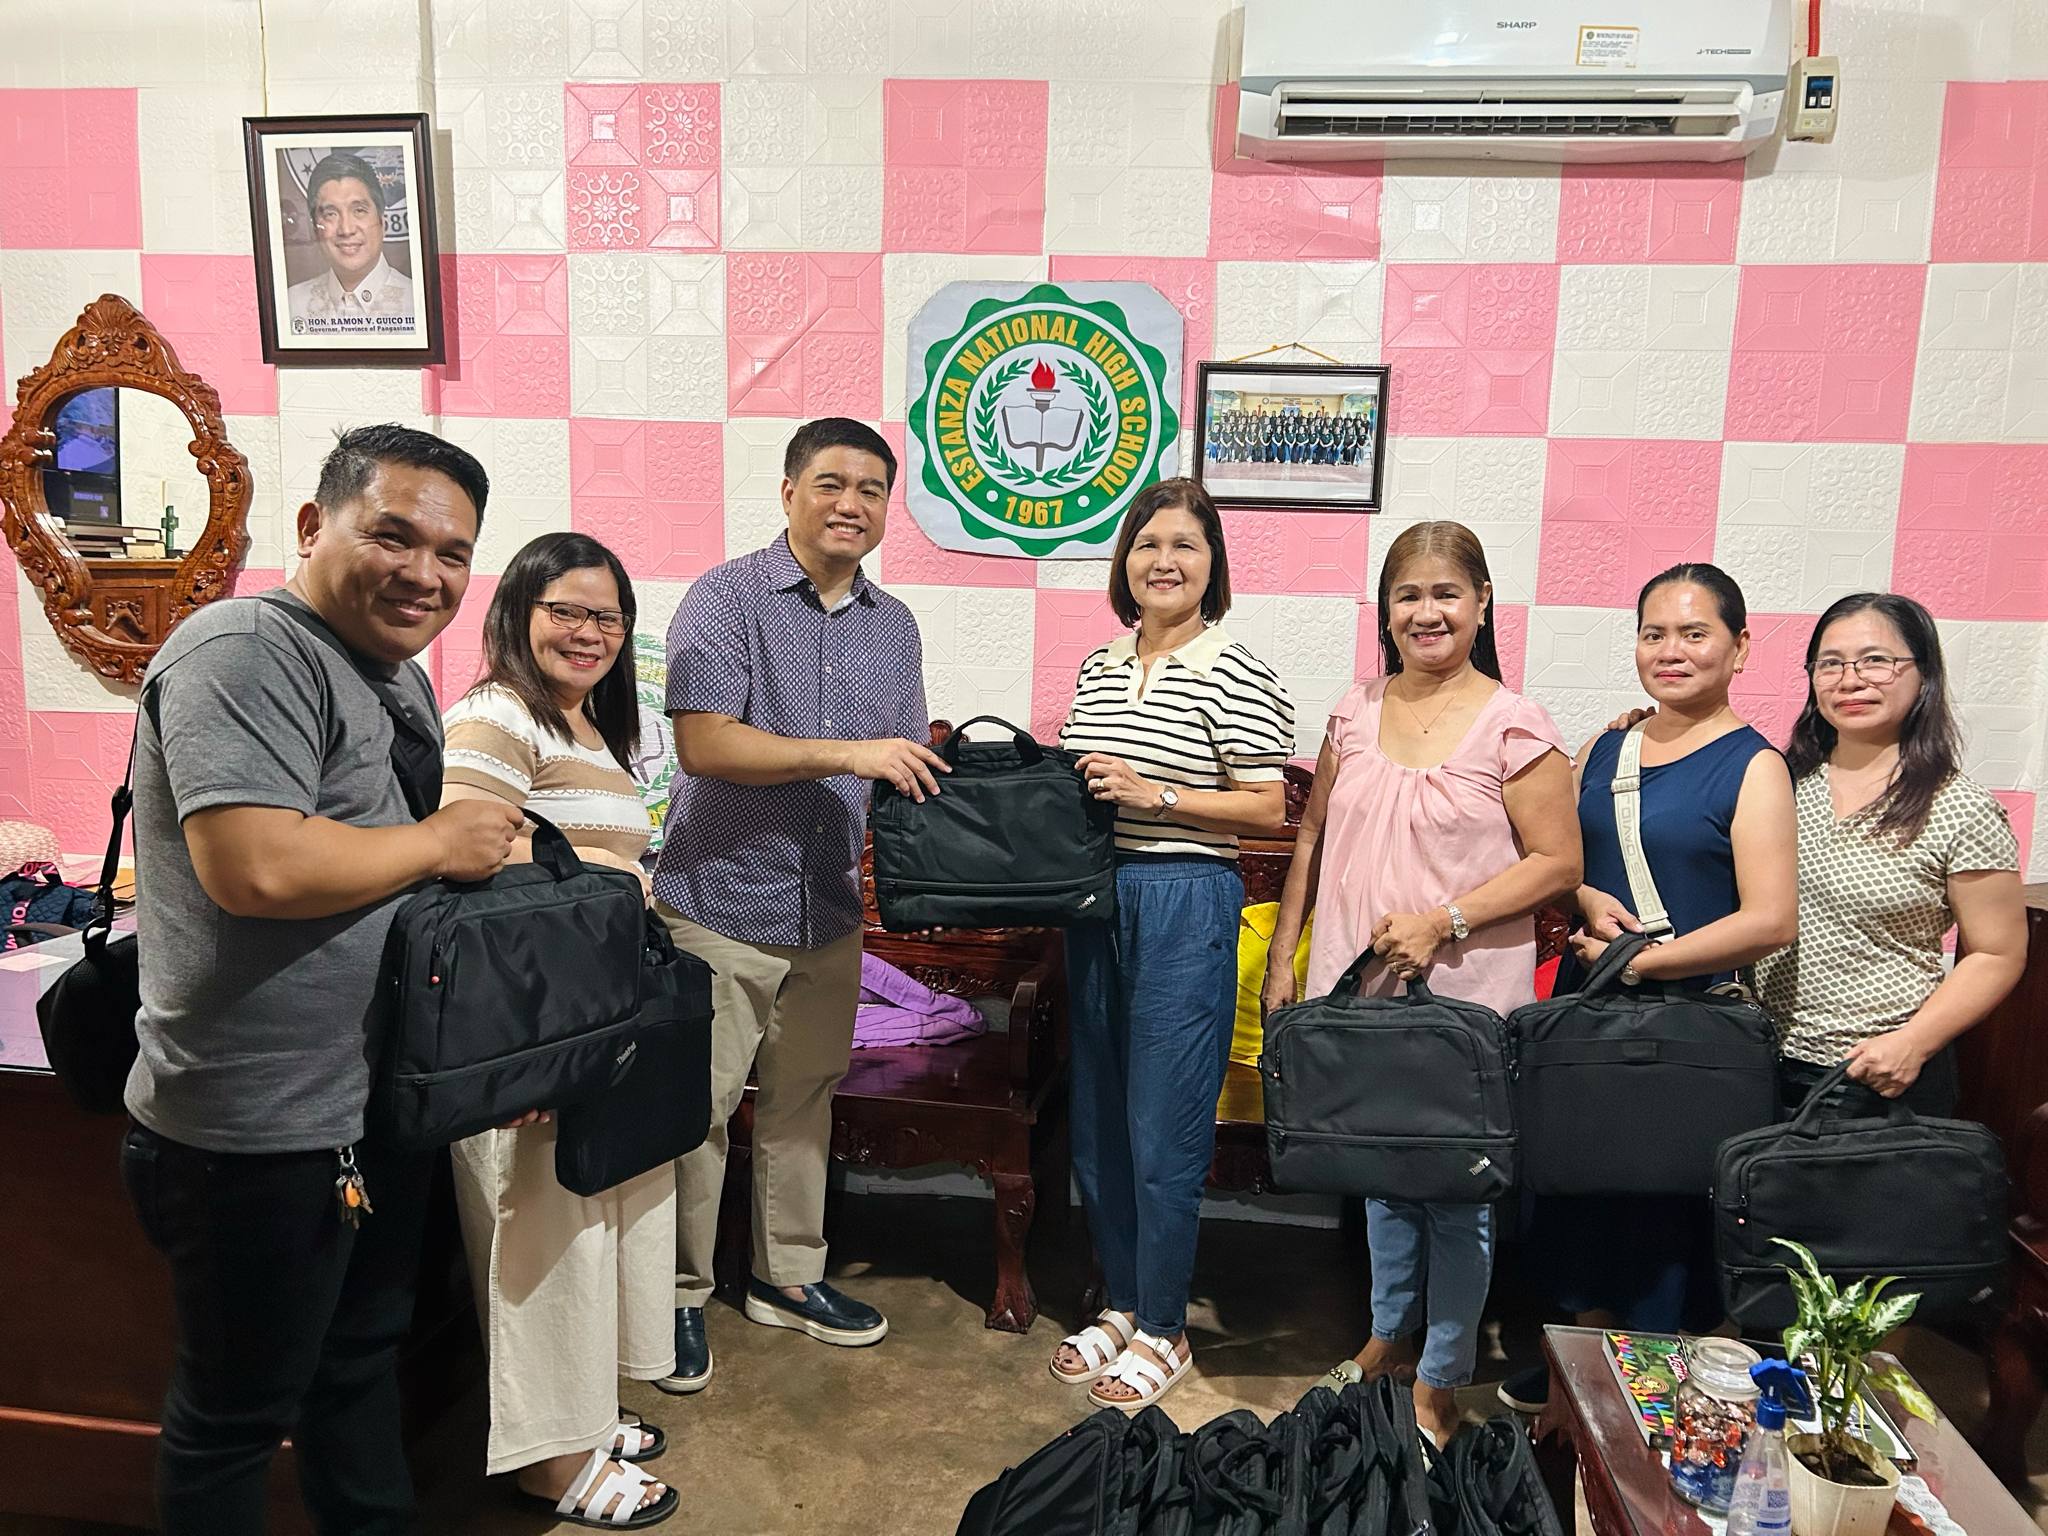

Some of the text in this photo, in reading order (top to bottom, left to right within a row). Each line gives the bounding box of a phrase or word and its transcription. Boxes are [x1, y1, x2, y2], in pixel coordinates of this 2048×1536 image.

[1496, 21, 1537, 29] SHARP
[308, 316, 415, 326] HON. RAMON V. GUICO III
[341, 325, 368, 333] Province
[377, 325, 415, 333] Pangasinan
[938, 315, 1148, 496] ESTANZA NATIONAL HIGH SCHOOL
[1004, 496, 1064, 526] 1967
